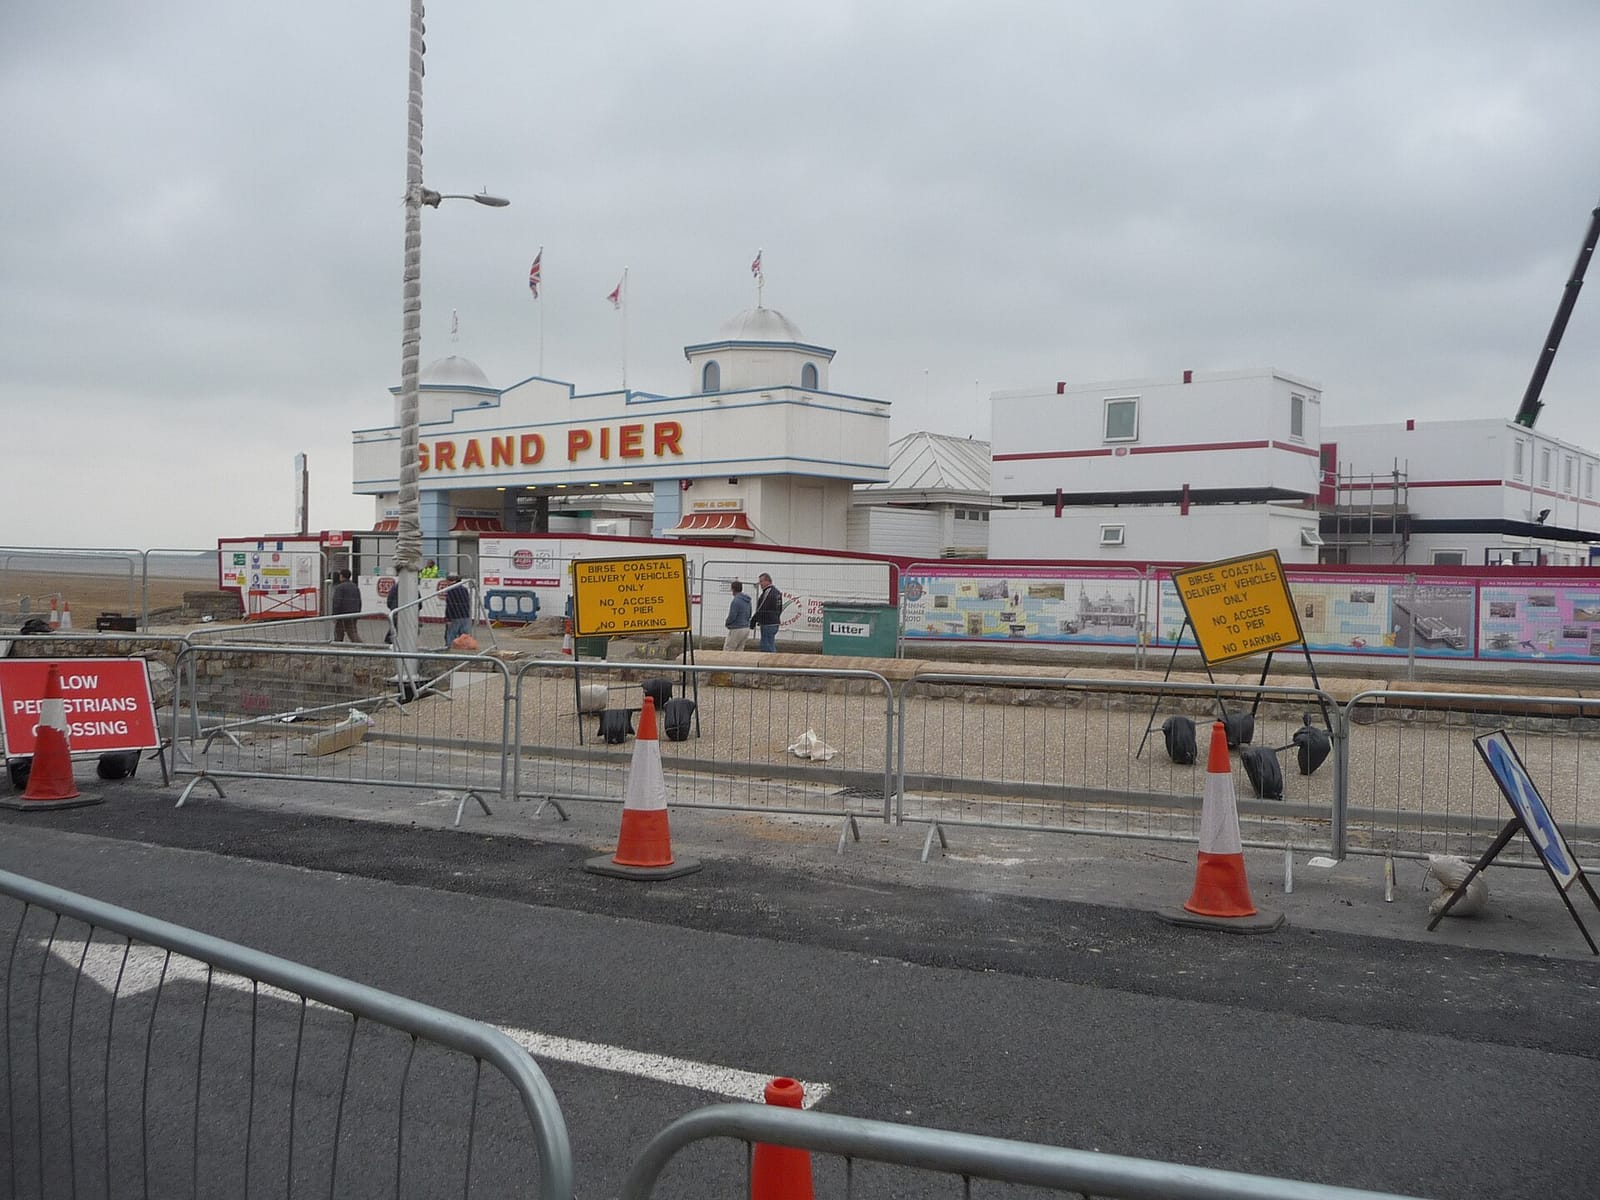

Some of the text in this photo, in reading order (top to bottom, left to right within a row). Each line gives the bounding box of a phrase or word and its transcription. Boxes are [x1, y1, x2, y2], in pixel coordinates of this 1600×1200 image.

[567, 421, 684, 461] PIER
[588, 562, 671, 573] BIRSE COASTAL
[1188, 562, 1266, 586] BIRSE COASTAL
[581, 571, 679, 583] DELIVERY VEHICLES
[618, 584, 644, 592] ONLY
[1185, 572, 1276, 599] DELIVERY VEHICLES
[599, 596, 663, 607] NO ACCESS
[1224, 592, 1248, 605] ONLY
[1213, 605, 1271, 626] NO ACCESS
[600, 619, 666, 629] NO PARKING
[831, 624, 865, 634] Litter
[1227, 619, 1265, 634] TO PIER
[1223, 633, 1281, 654] NO PARKING
[59, 675, 99, 690] LOW
[13, 697, 137, 714] PESTRIANS
